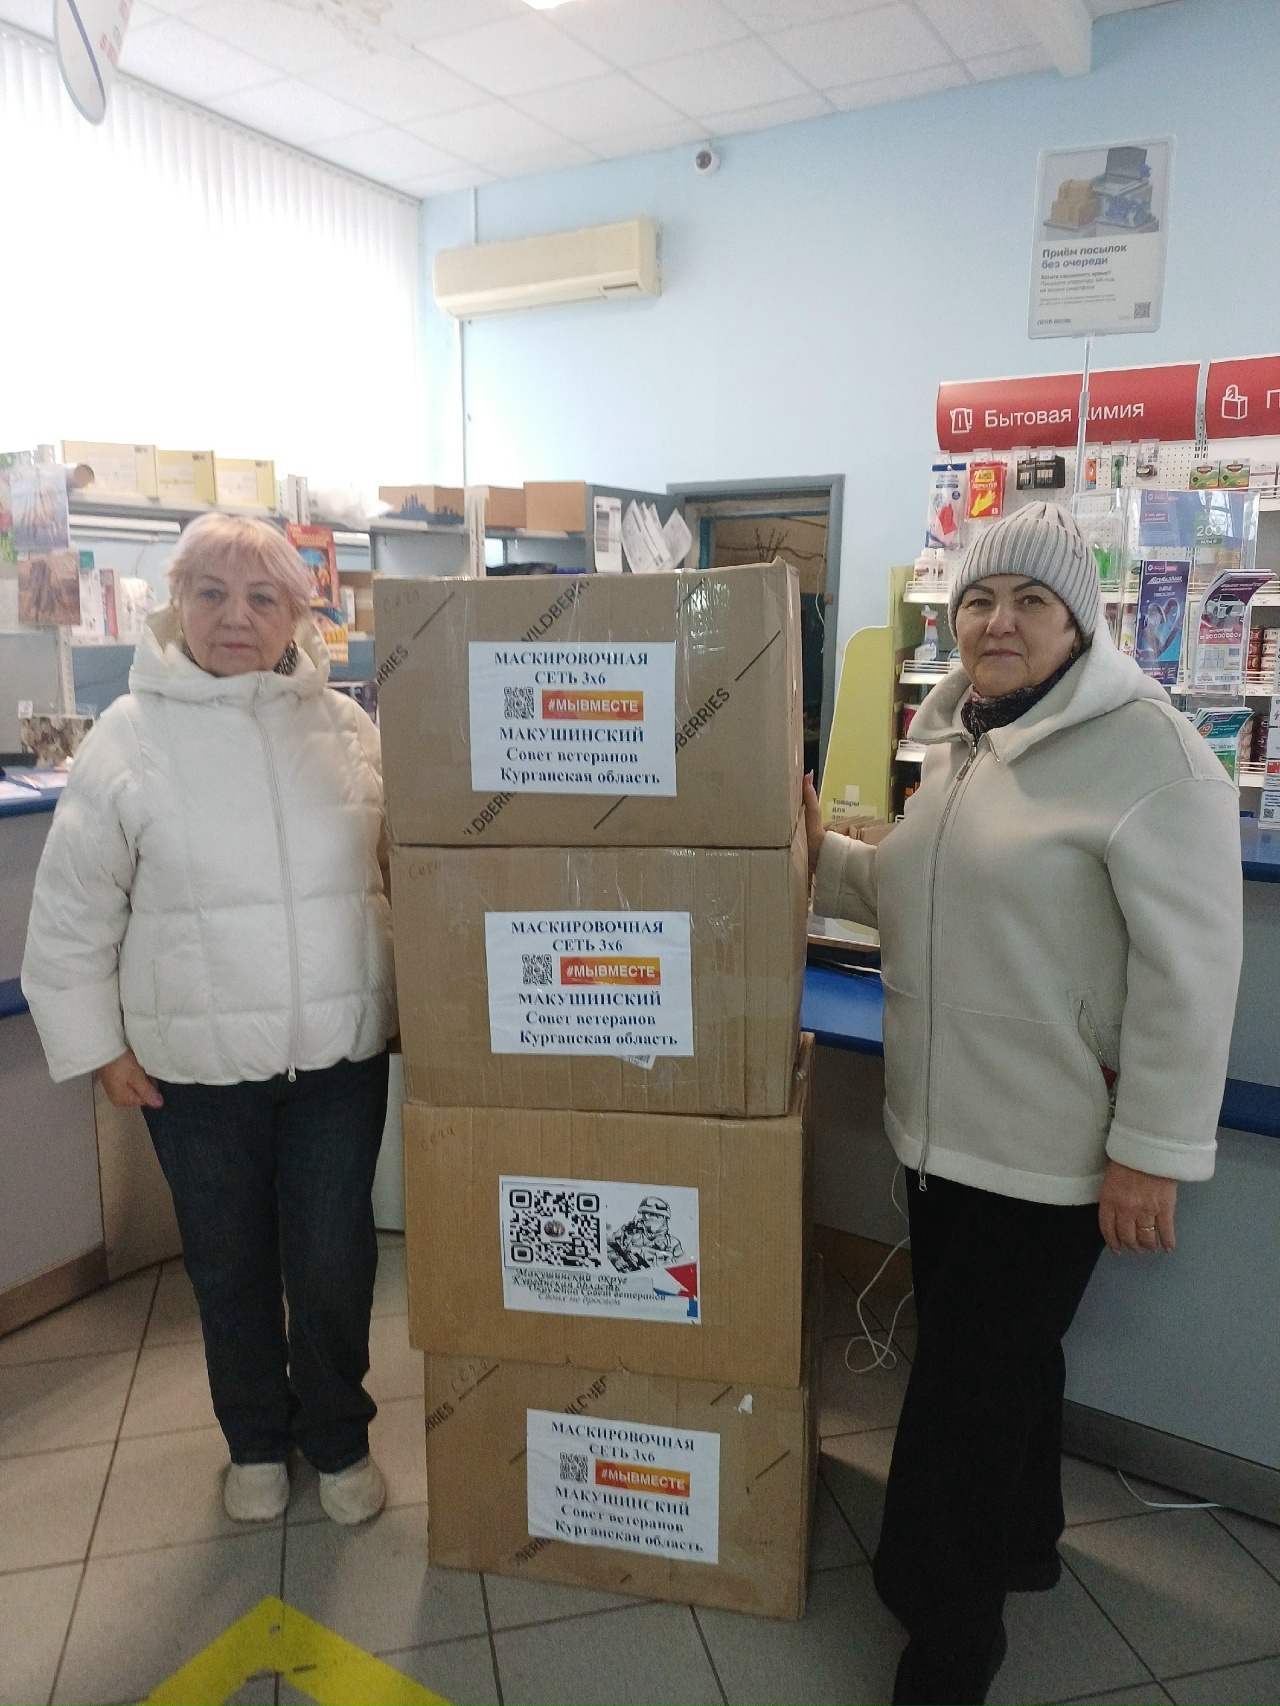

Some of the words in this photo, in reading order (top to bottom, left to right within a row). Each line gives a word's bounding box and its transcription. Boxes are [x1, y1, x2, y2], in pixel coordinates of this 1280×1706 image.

[1042, 248, 1077, 259] Приём
[1080, 244, 1127, 255] посылок
[1041, 260, 1060, 269] без
[1063, 257, 1108, 268] очереди
[984, 408, 1072, 428] Бытовая
[1079, 402, 1144, 422] имия
[1196, 525, 1223, 537] 200
[521, 581, 589, 642] ILDBERR
[495, 652, 648, 665] МАСКИРОВОЧНАЯ
[534, 671, 577, 684] СЕТЬ
[548, 699, 638, 713] #МЫВМЕСТЕ
[675, 688, 730, 754] BERRIES
[499, 726, 645, 742] МАКУШИНСКИЙ
[506, 747, 552, 762] Совет
[557, 750, 638, 765] ветеранов
[500, 766, 593, 785] Курганская
[597, 769, 660, 784] область
[832, 798, 860, 807] Товары
[511, 920, 663, 934] МАСКИРОВОЧНАЯ
[552, 939, 595, 952] СЕТЬ
[566, 964, 656, 978] #МЫВМЕСТЕ
[519, 991, 661, 1006] МАКУШИНСКИЙ
[526, 1011, 571, 1025] Совет
[576, 1014, 656, 1028] ветеранов
[520, 1030, 611, 1048] Курганская
[616, 1032, 678, 1046] область
[513, 1275, 573, 1291] Курганская
[577, 1280, 620, 1292] область
[516, 1268, 591, 1282] Макушинский
[598, 1275, 627, 1286] округ
[614, 1291, 666, 1301] ветеранов
[551, 1421, 694, 1451] МАСКИРОВОЧНАЯ
[589, 1443, 629, 1459] СЕТЬ
[601, 1468, 685, 1491] #МЫВМЕСТЕ
[555, 1485, 690, 1516] МАКУШИНСКИЙ
[560, 1503, 605, 1520] Совет
[608, 1512, 684, 1533] ветеранов
[555, 1519, 641, 1543] Курганская
[645, 1535, 704, 1553] область
